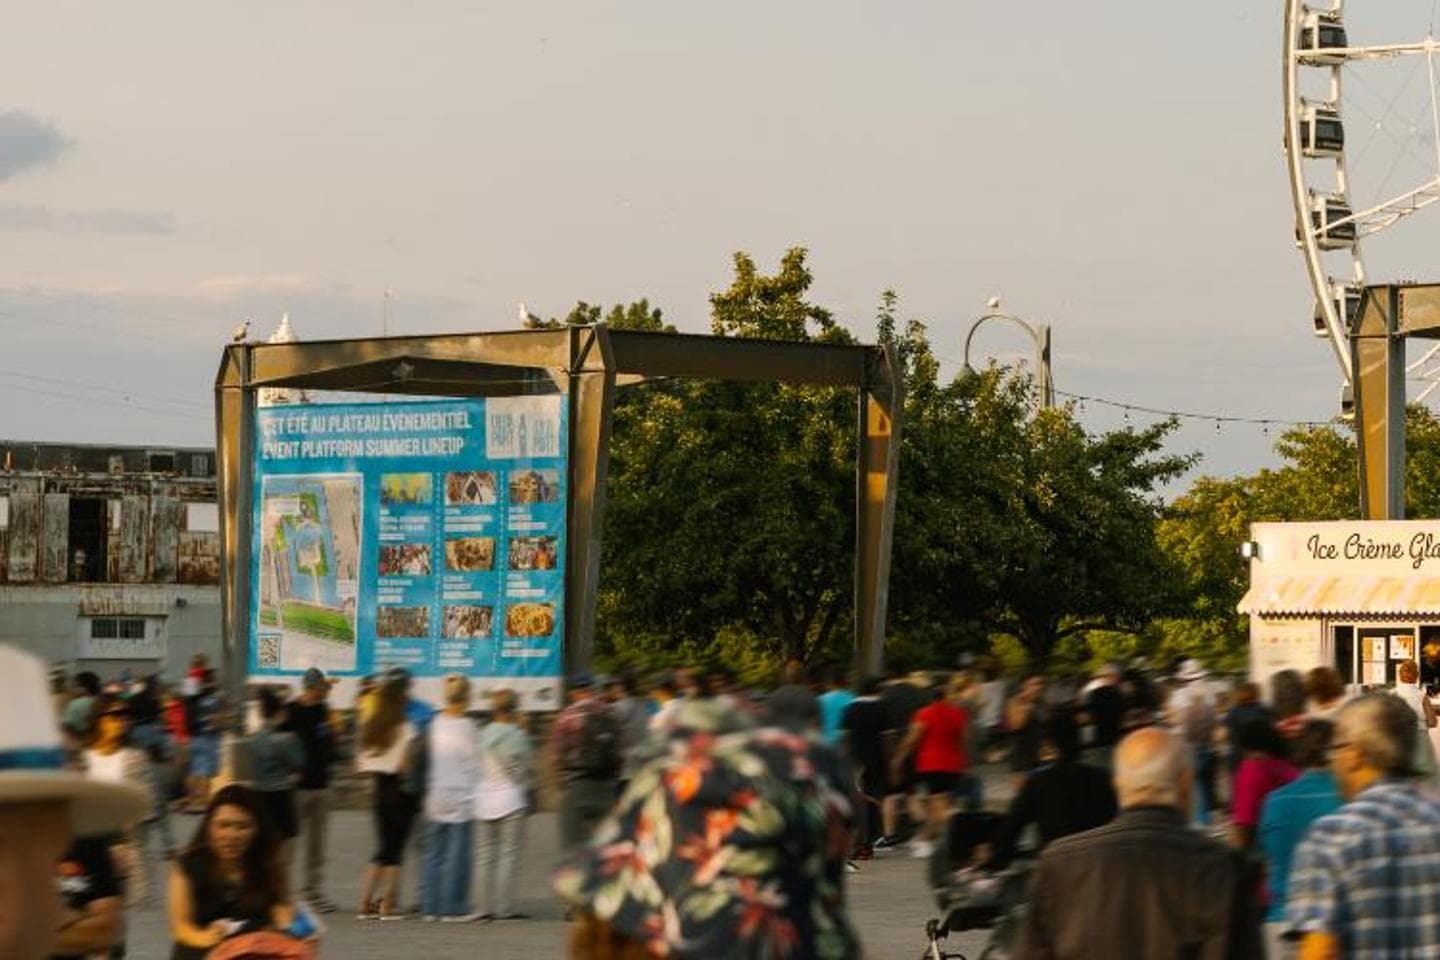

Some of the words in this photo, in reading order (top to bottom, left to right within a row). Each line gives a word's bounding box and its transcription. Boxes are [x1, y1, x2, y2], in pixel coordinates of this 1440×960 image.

[287, 412, 308, 434] ÉTÉ
[312, 415, 326, 433] AU
[328, 414, 380, 433] PLATEAU
[262, 440, 300, 459] EVENT
[302, 439, 364, 458] PLATFORM
[366, 437, 420, 456] SUMMER
[421, 435, 464, 455] LINEUP
[1307, 533, 1339, 560] Ice
[1343, 532, 1404, 560] Crème
